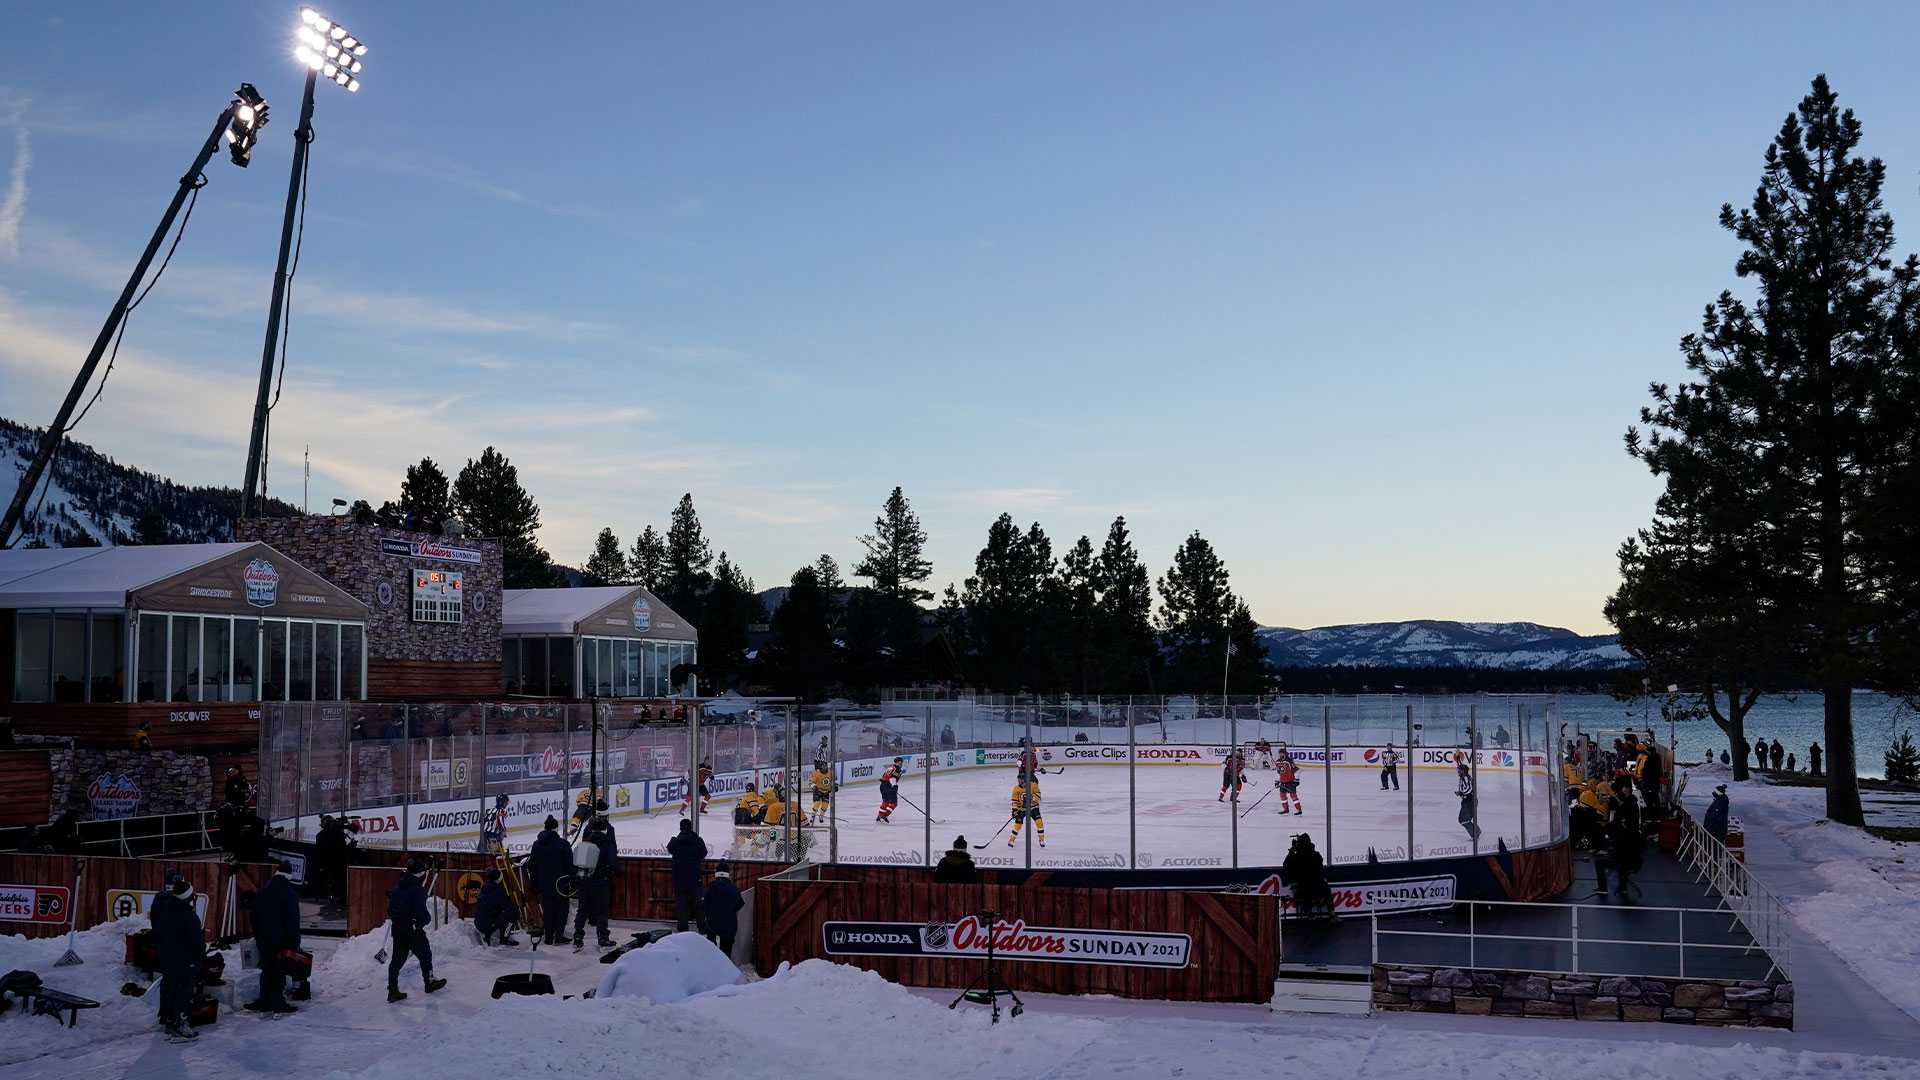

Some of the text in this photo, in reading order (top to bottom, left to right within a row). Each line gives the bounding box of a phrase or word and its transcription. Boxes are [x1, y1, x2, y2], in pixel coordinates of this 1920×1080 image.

[421, 540, 452, 558] Outdoors
[452, 552, 472, 560] SUNDAY
[170, 711, 210, 722] DISCOVER
[1065, 747, 1127, 760] Great Clips
[1137, 749, 1202, 759] HONDA
[851, 763, 873, 778] verizon
[88, 781, 140, 799] Outdoors
[1365, 886, 1429, 905] SUNDAY
[1430, 886, 1449, 897] 2021
[847, 932, 914, 944] HONDA
[952, 917, 1065, 953] Outdoors
[1069, 938, 1149, 955] SUNDAY
[1152, 945, 1180, 956] 2021
